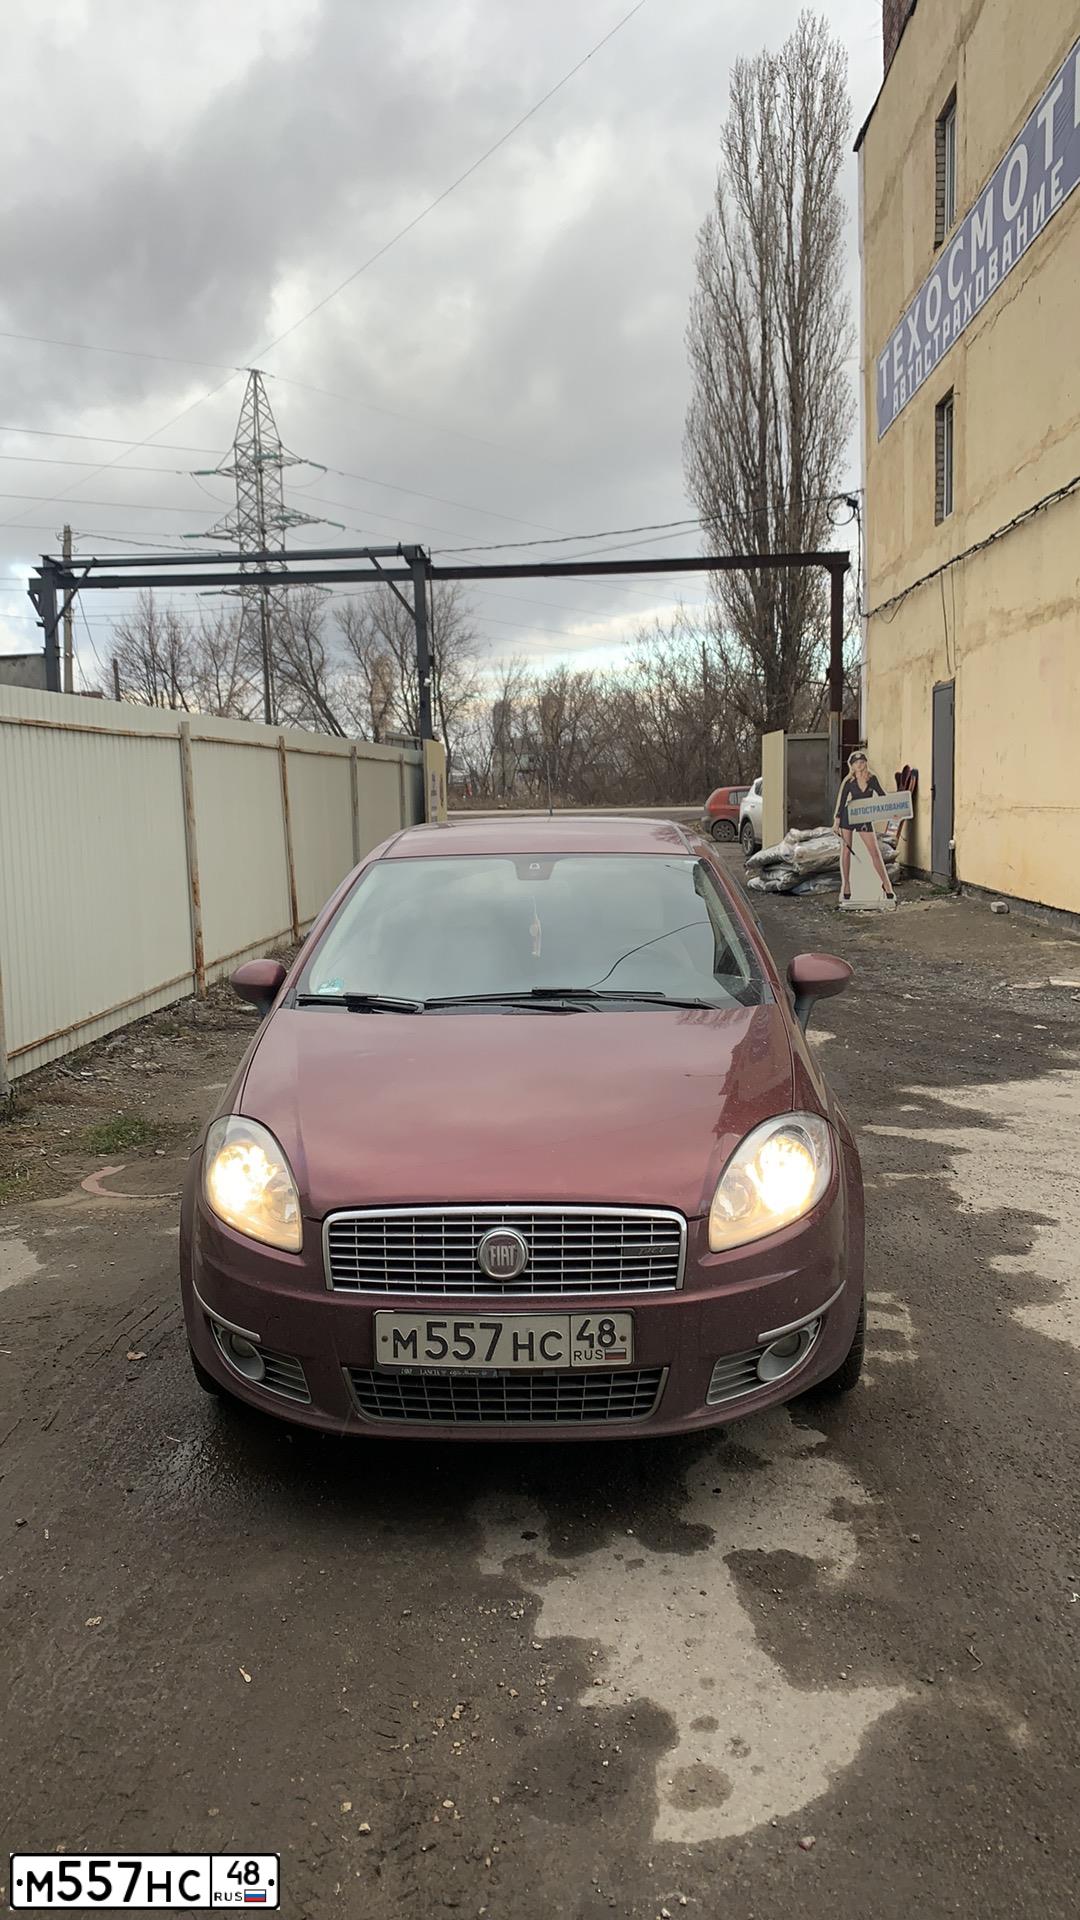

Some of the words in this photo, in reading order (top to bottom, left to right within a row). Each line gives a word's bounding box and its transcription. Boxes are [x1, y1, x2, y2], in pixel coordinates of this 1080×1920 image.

[892, 156, 1064, 417] АВТОСТРАХОВАНИЕ
[850, 800, 909, 816] АВТОСТРАХОВАНИЕ
[489, 1245, 516, 1266] FIAT
[576, 1318, 617, 1349] 48
[573, 1350, 604, 1361] RUS
